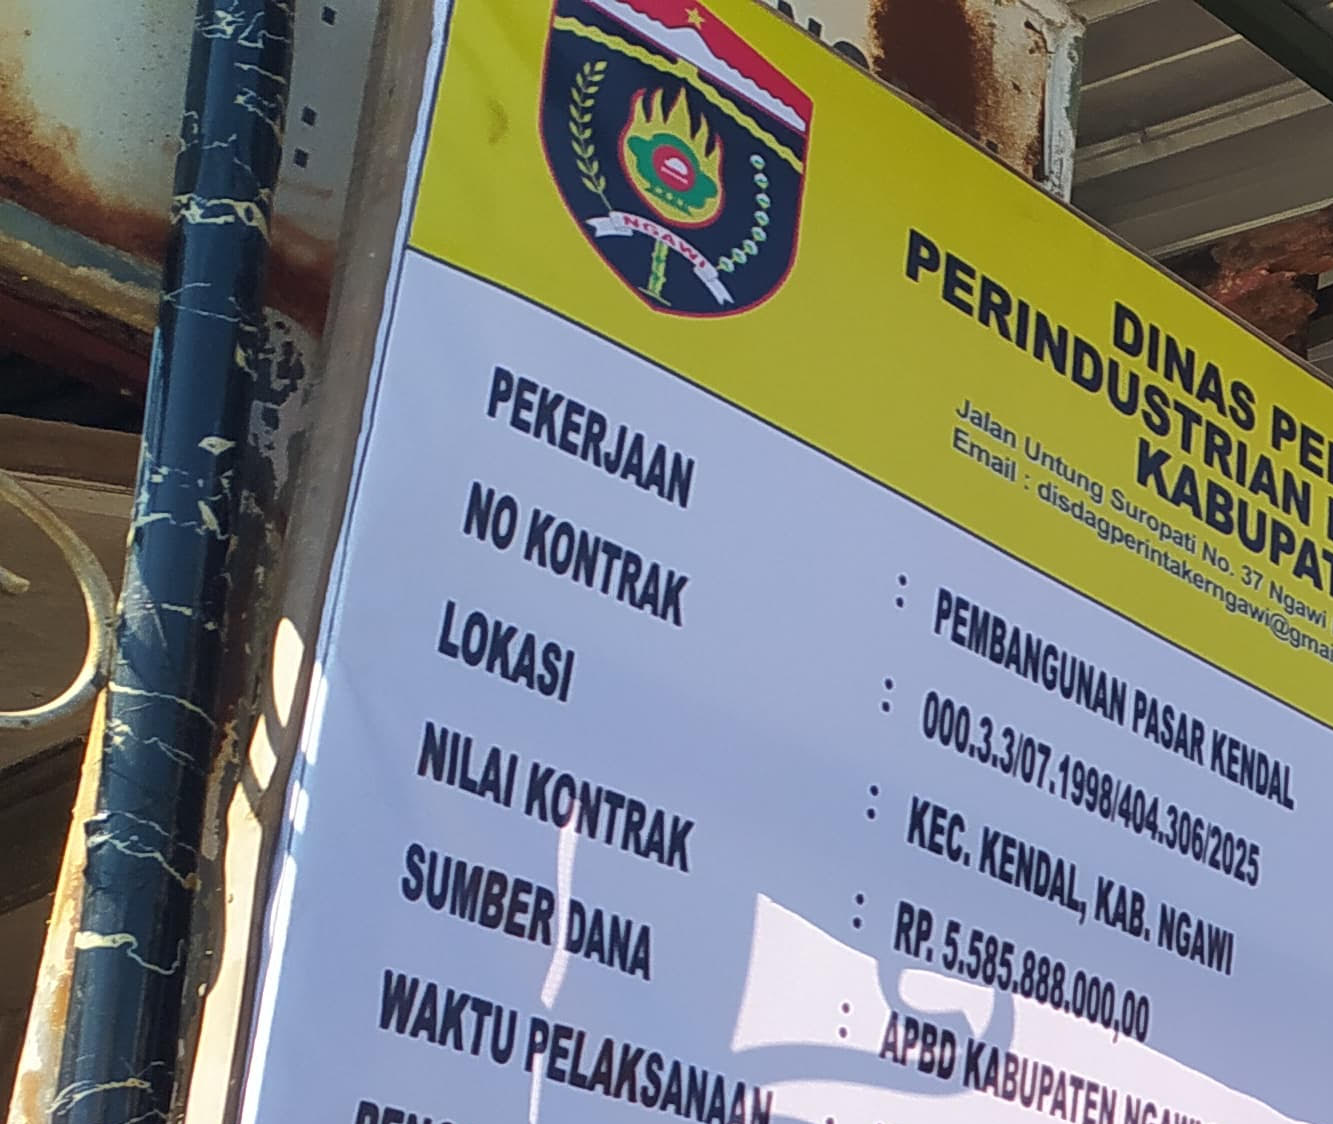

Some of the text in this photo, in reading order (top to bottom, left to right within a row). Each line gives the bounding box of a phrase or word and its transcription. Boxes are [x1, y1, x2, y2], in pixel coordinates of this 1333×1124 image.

[623, 215, 705, 268] NGAWI
[905, 228, 1311, 526] PERINDUSTRIAN
[953, 427, 1016, 482] Email
[1112, 300, 1256, 431] DINAS
[487, 366, 695, 508] PEKERJAAN
[934, 588, 1127, 727] PEMBANGUNAN
[1132, 688, 1205, 767] PASAR
[1210, 729, 1295, 811] KENDAL
[955, 400, 1017, 448] Jalan
[1024, 436, 1104, 505] Untung
[1110, 488, 1197, 553] Suropati
[1201, 542, 1235, 577] No.
[1240, 564, 1264, 590] 37
[1269, 580, 1327, 628] Ngawi
[437, 600, 575, 702] LOKASI
[906, 796, 971, 868] KEC.
[979, 826, 1087, 925] KENDAL,
[1094, 876, 1151, 943] KAB.
[1157, 903, 1234, 976] NGAWI
[462, 481, 518, 550] NO
[524, 508, 690, 627] KONTRAK
[923, 691, 1261, 887] 000.3.3/07.1998/404.306/2025
[401, 843, 553, 945] SUMBER
[564, 897, 652, 981] DANA
[879, 1011, 957, 1081] APBD
[417, 720, 519, 808] NILAI
[524, 761, 695, 873] KONTRAK
[894, 900, 934, 963] RP.
[942, 920, 1150, 1043] 5.585.888.000,00
[378, 969, 518, 1065] WAKTU
